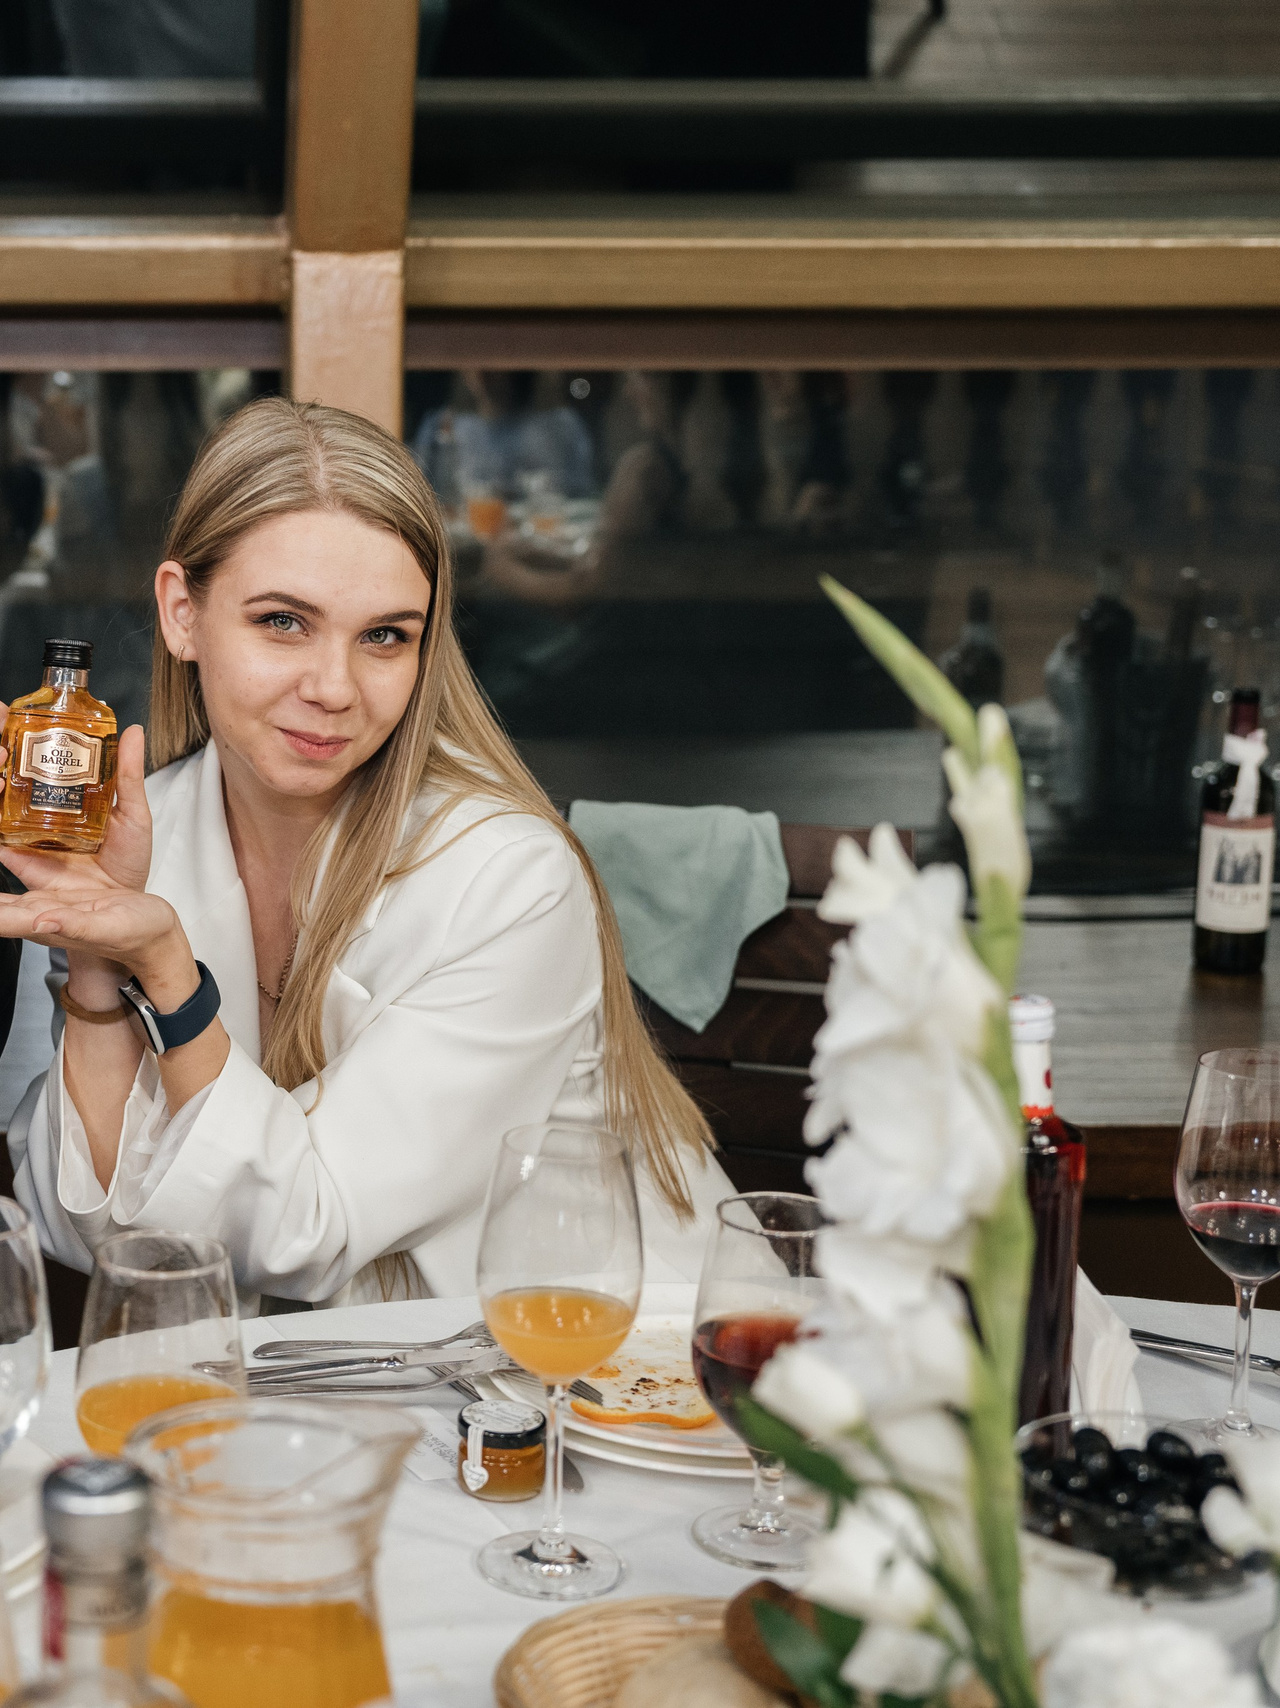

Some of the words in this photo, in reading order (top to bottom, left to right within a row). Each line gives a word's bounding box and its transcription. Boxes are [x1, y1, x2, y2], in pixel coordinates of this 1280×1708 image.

[51, 749, 73, 758] OLD
[41, 754, 83, 767] BARREL
[58, 766, 64, 774] 5
